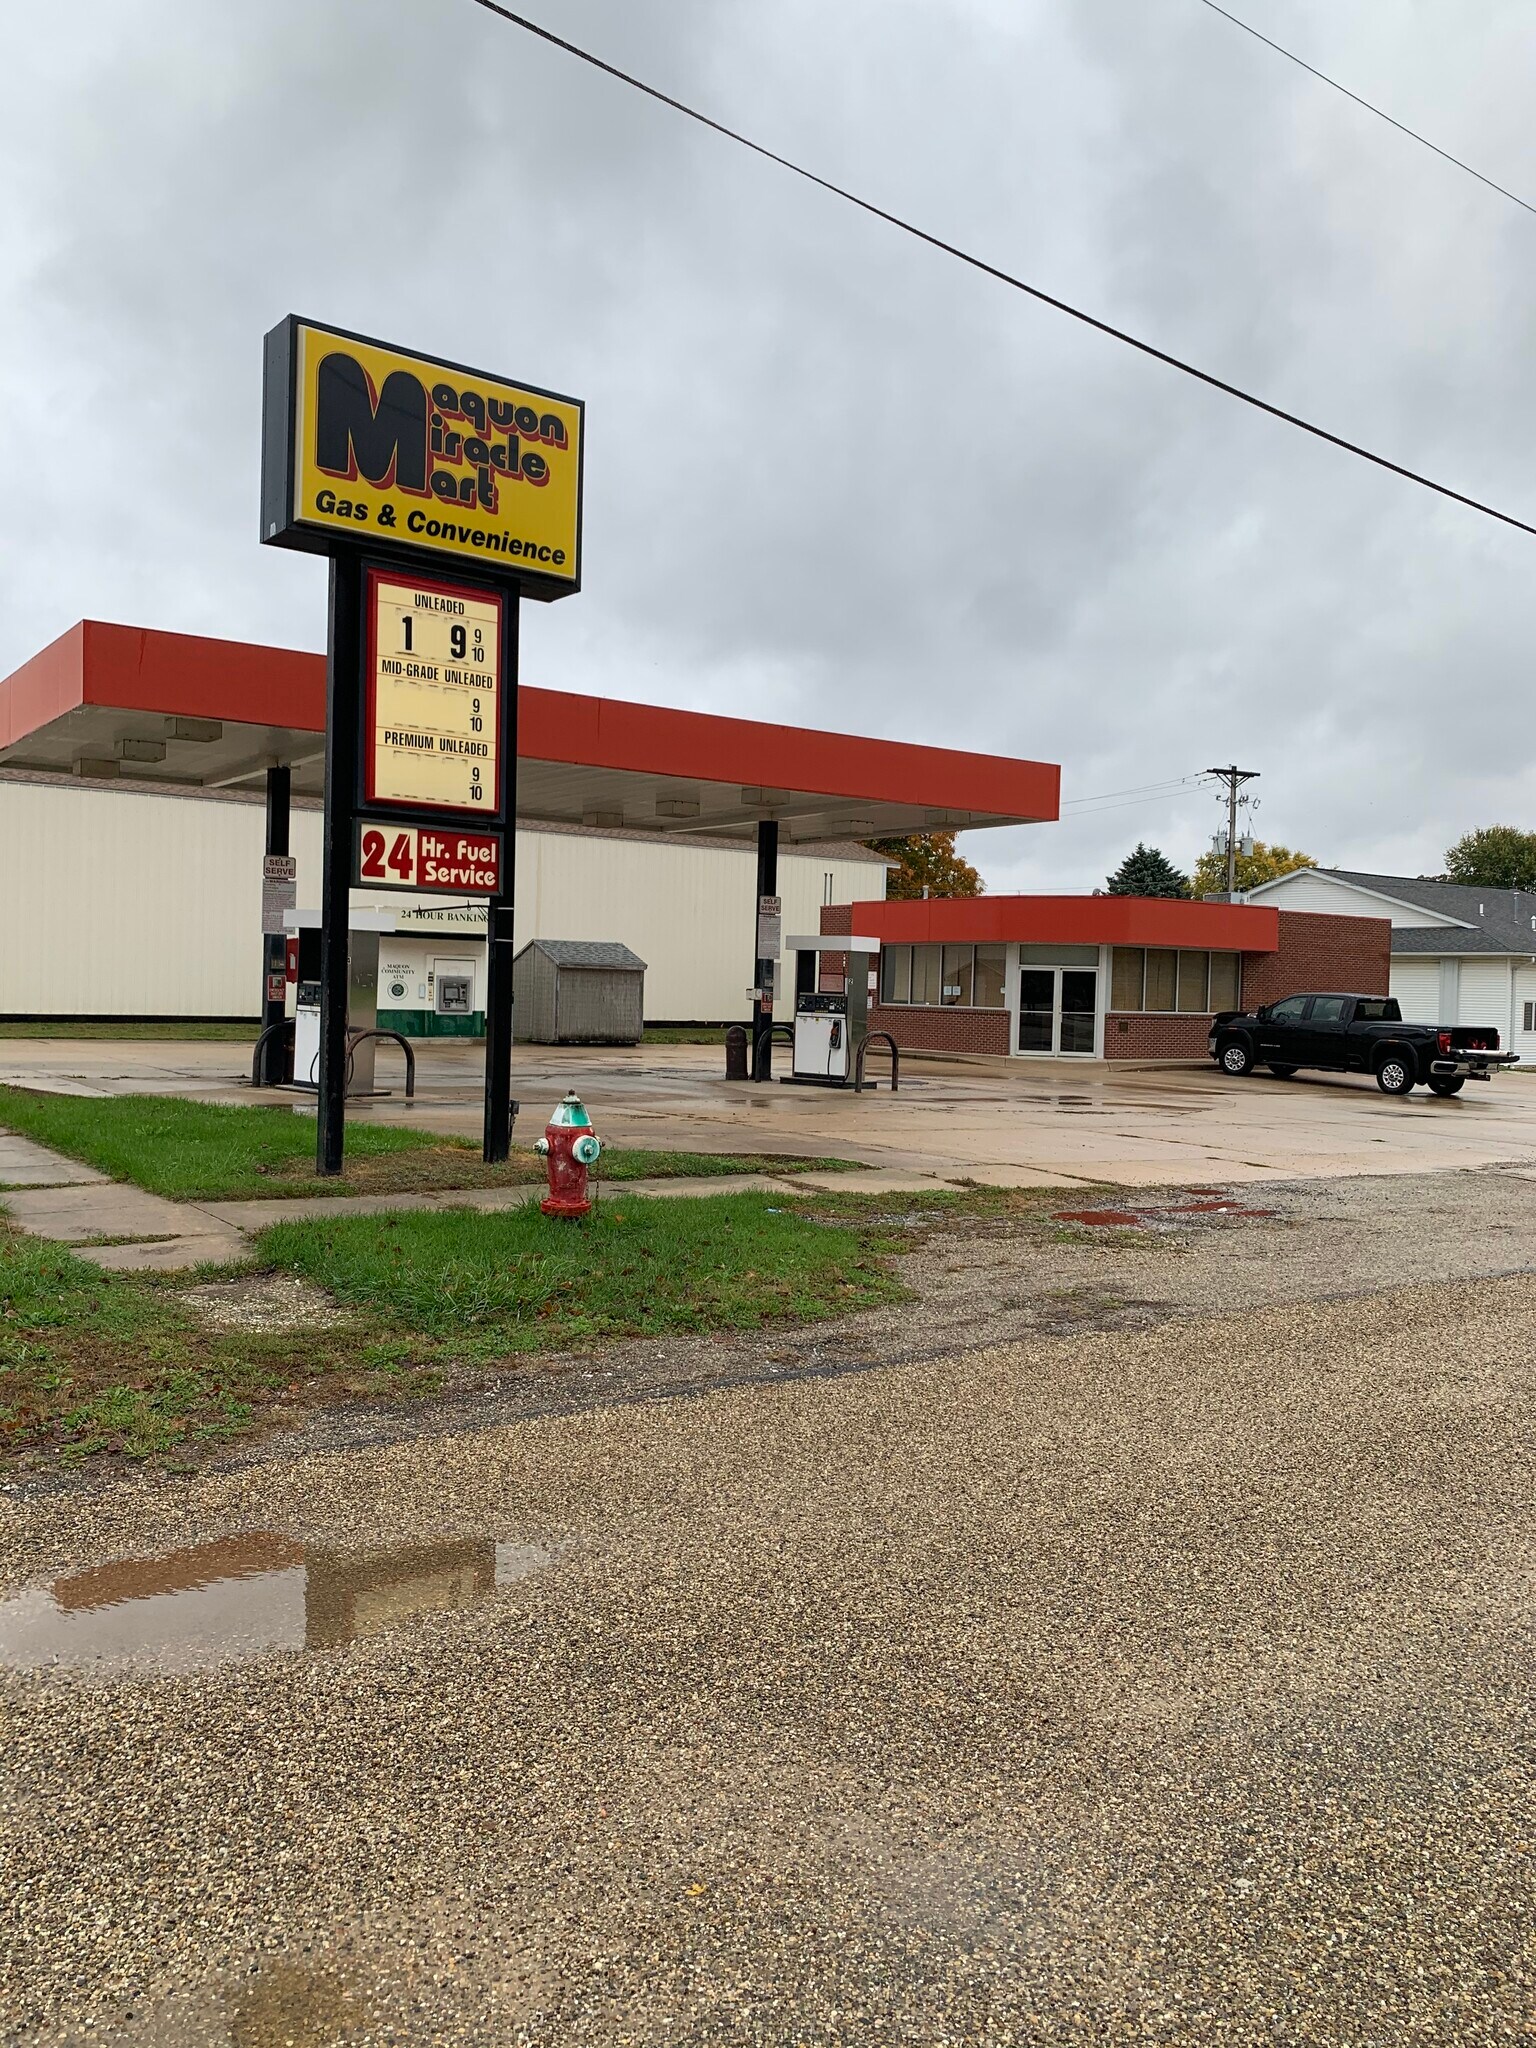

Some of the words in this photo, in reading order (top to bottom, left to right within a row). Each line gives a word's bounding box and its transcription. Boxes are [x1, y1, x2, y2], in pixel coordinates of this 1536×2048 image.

[315, 489, 369, 521] Gas
[377, 503, 396, 528] &
[406, 510, 566, 566] Convenience
[414, 593, 464, 615] UNLEADED
[402, 615, 413, 651] 1
[450, 624, 466, 659] 9
[474, 628, 482, 644] 9
[471, 646, 485, 663] 10
[381, 659, 439, 681] MID-GRADE
[444, 669, 493, 689] UNLEADED
[472, 698, 480, 714] 9
[469, 716, 482, 732] 10
[384, 731, 434, 750] PREMIUM
[439, 738, 488, 757] UNLEADED
[472, 767, 480, 782] 9
[469, 785, 482, 801] 10
[269, 859, 291, 867] SELF
[361, 830, 414, 880] 24
[421, 836, 450, 859] Hr.
[457, 839, 496, 863] Fuel
[265, 867, 294, 876] SERVE
[425, 860, 496, 886] Service
[401, 910, 411, 919] 24
[416, 910, 444, 921] HOUR
